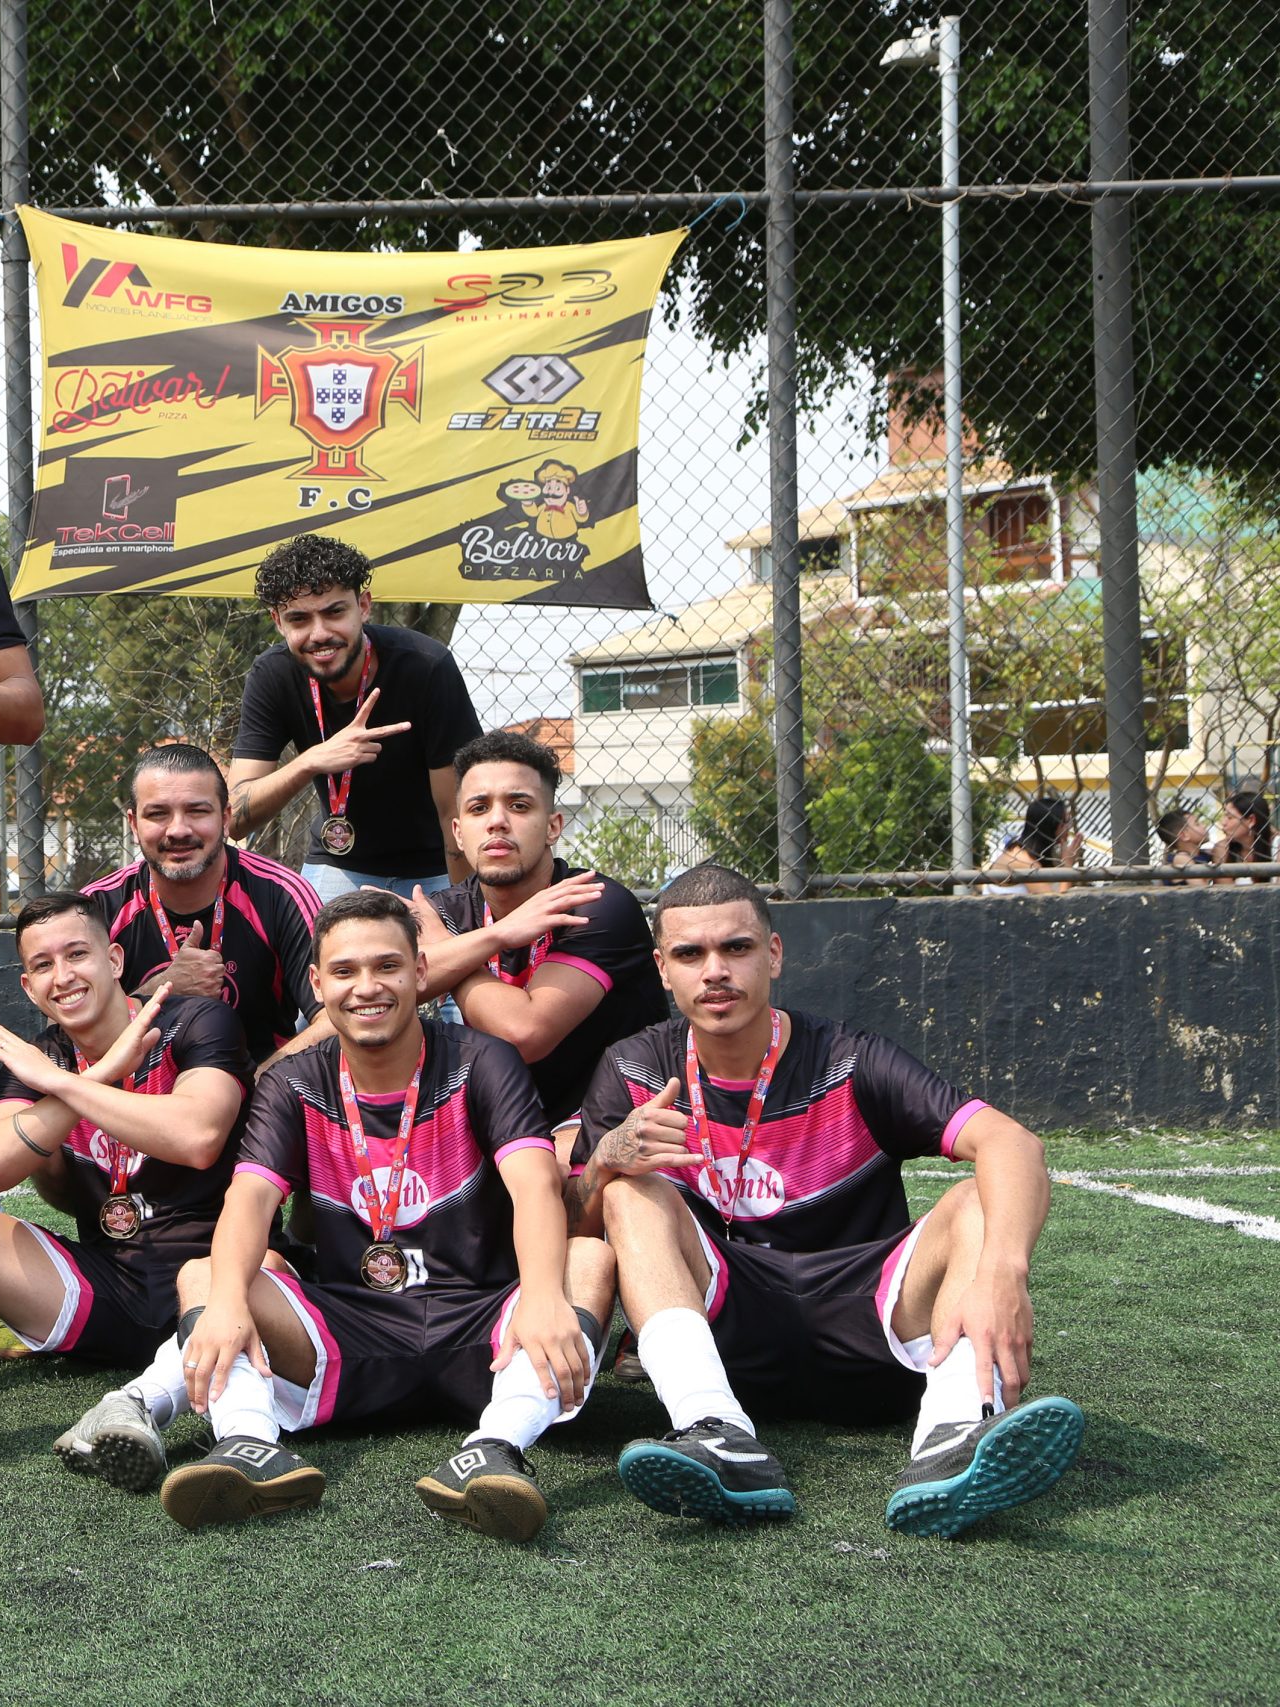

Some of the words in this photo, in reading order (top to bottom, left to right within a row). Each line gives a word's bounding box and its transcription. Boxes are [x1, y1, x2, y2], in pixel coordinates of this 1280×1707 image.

[124, 289, 212, 313] WFG
[279, 293, 403, 313] AMIGOS
[158, 412, 188, 420] PIZZA
[447, 407, 526, 431] SE7E
[525, 407, 602, 431] TR3S
[528, 430, 599, 442] ESPORTES
[52, 545, 104, 557] Especialista
[461, 525, 584, 564] Bolivar
[464, 565, 584, 580] PIZZARIA
